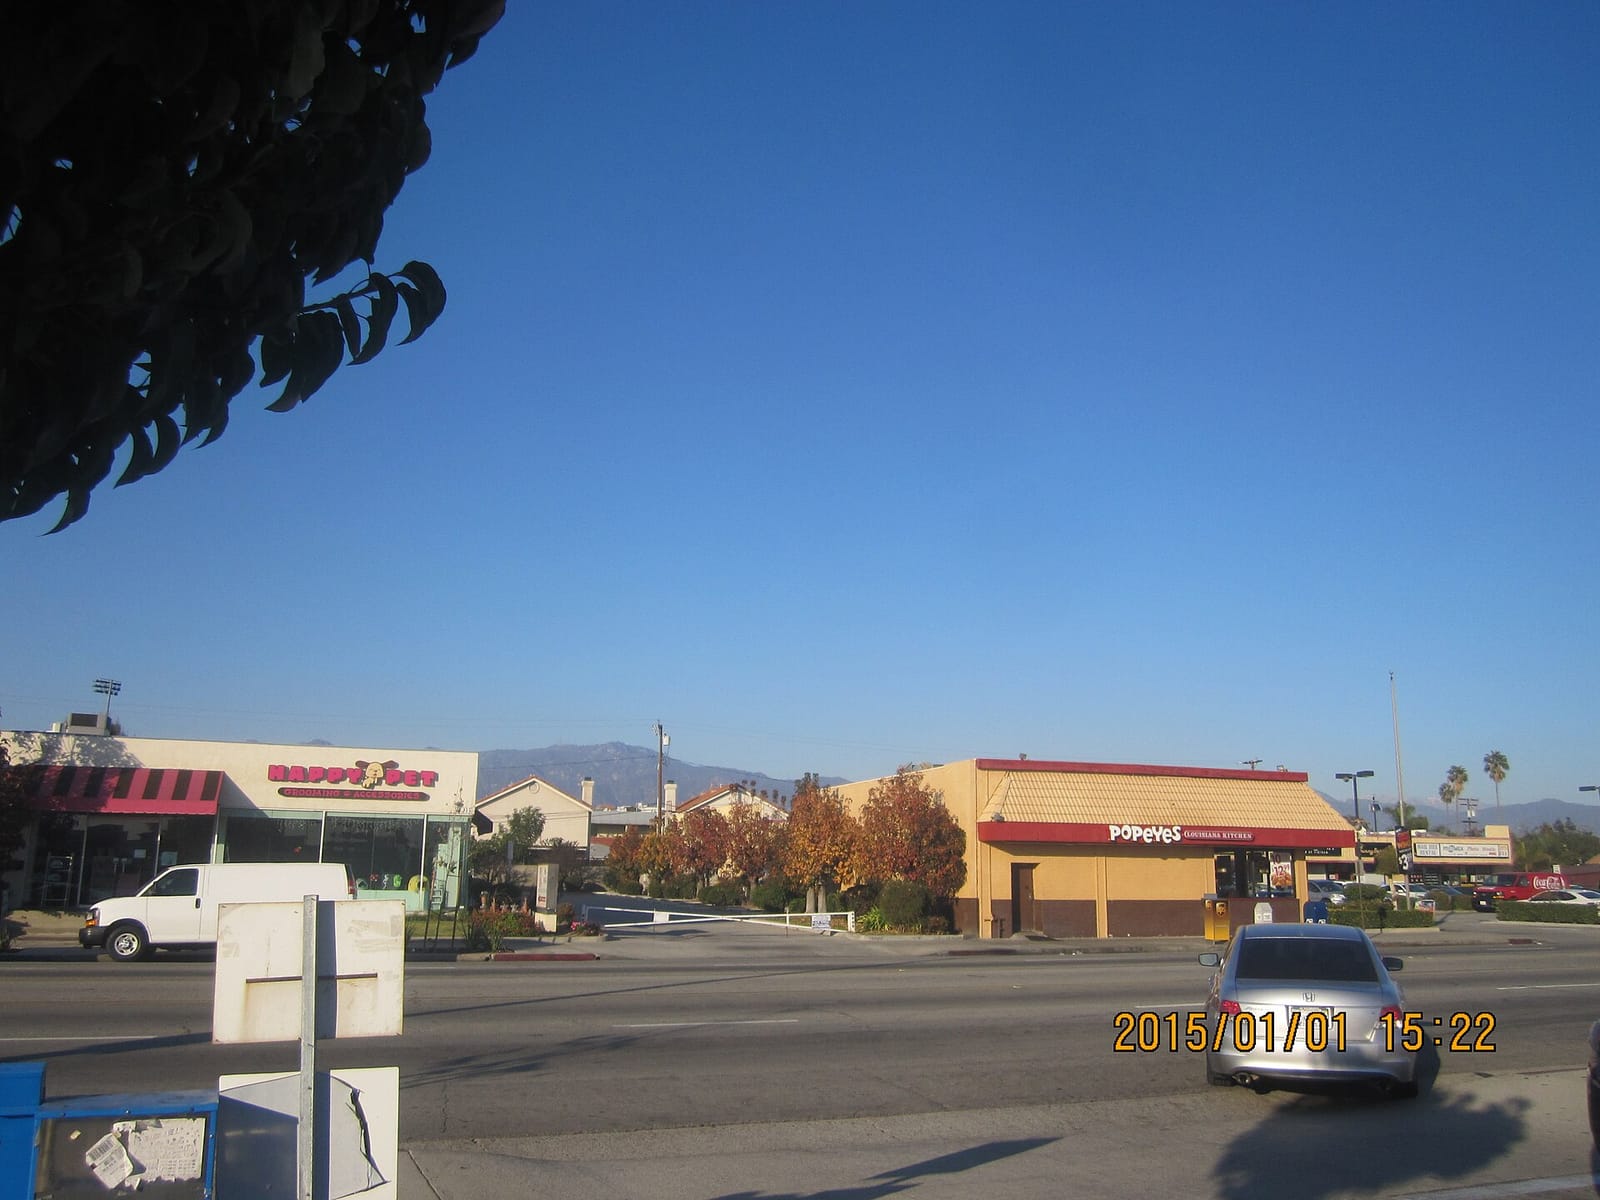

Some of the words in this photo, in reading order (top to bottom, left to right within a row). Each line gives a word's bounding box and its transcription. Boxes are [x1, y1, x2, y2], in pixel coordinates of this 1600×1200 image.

[268, 764, 364, 785] HAPPY
[385, 769, 438, 787] PET
[283, 788, 341, 797] GROOMING
[1185, 830, 1221, 839] LOUISIANA
[1222, 832, 1252, 840] KITCHEN
